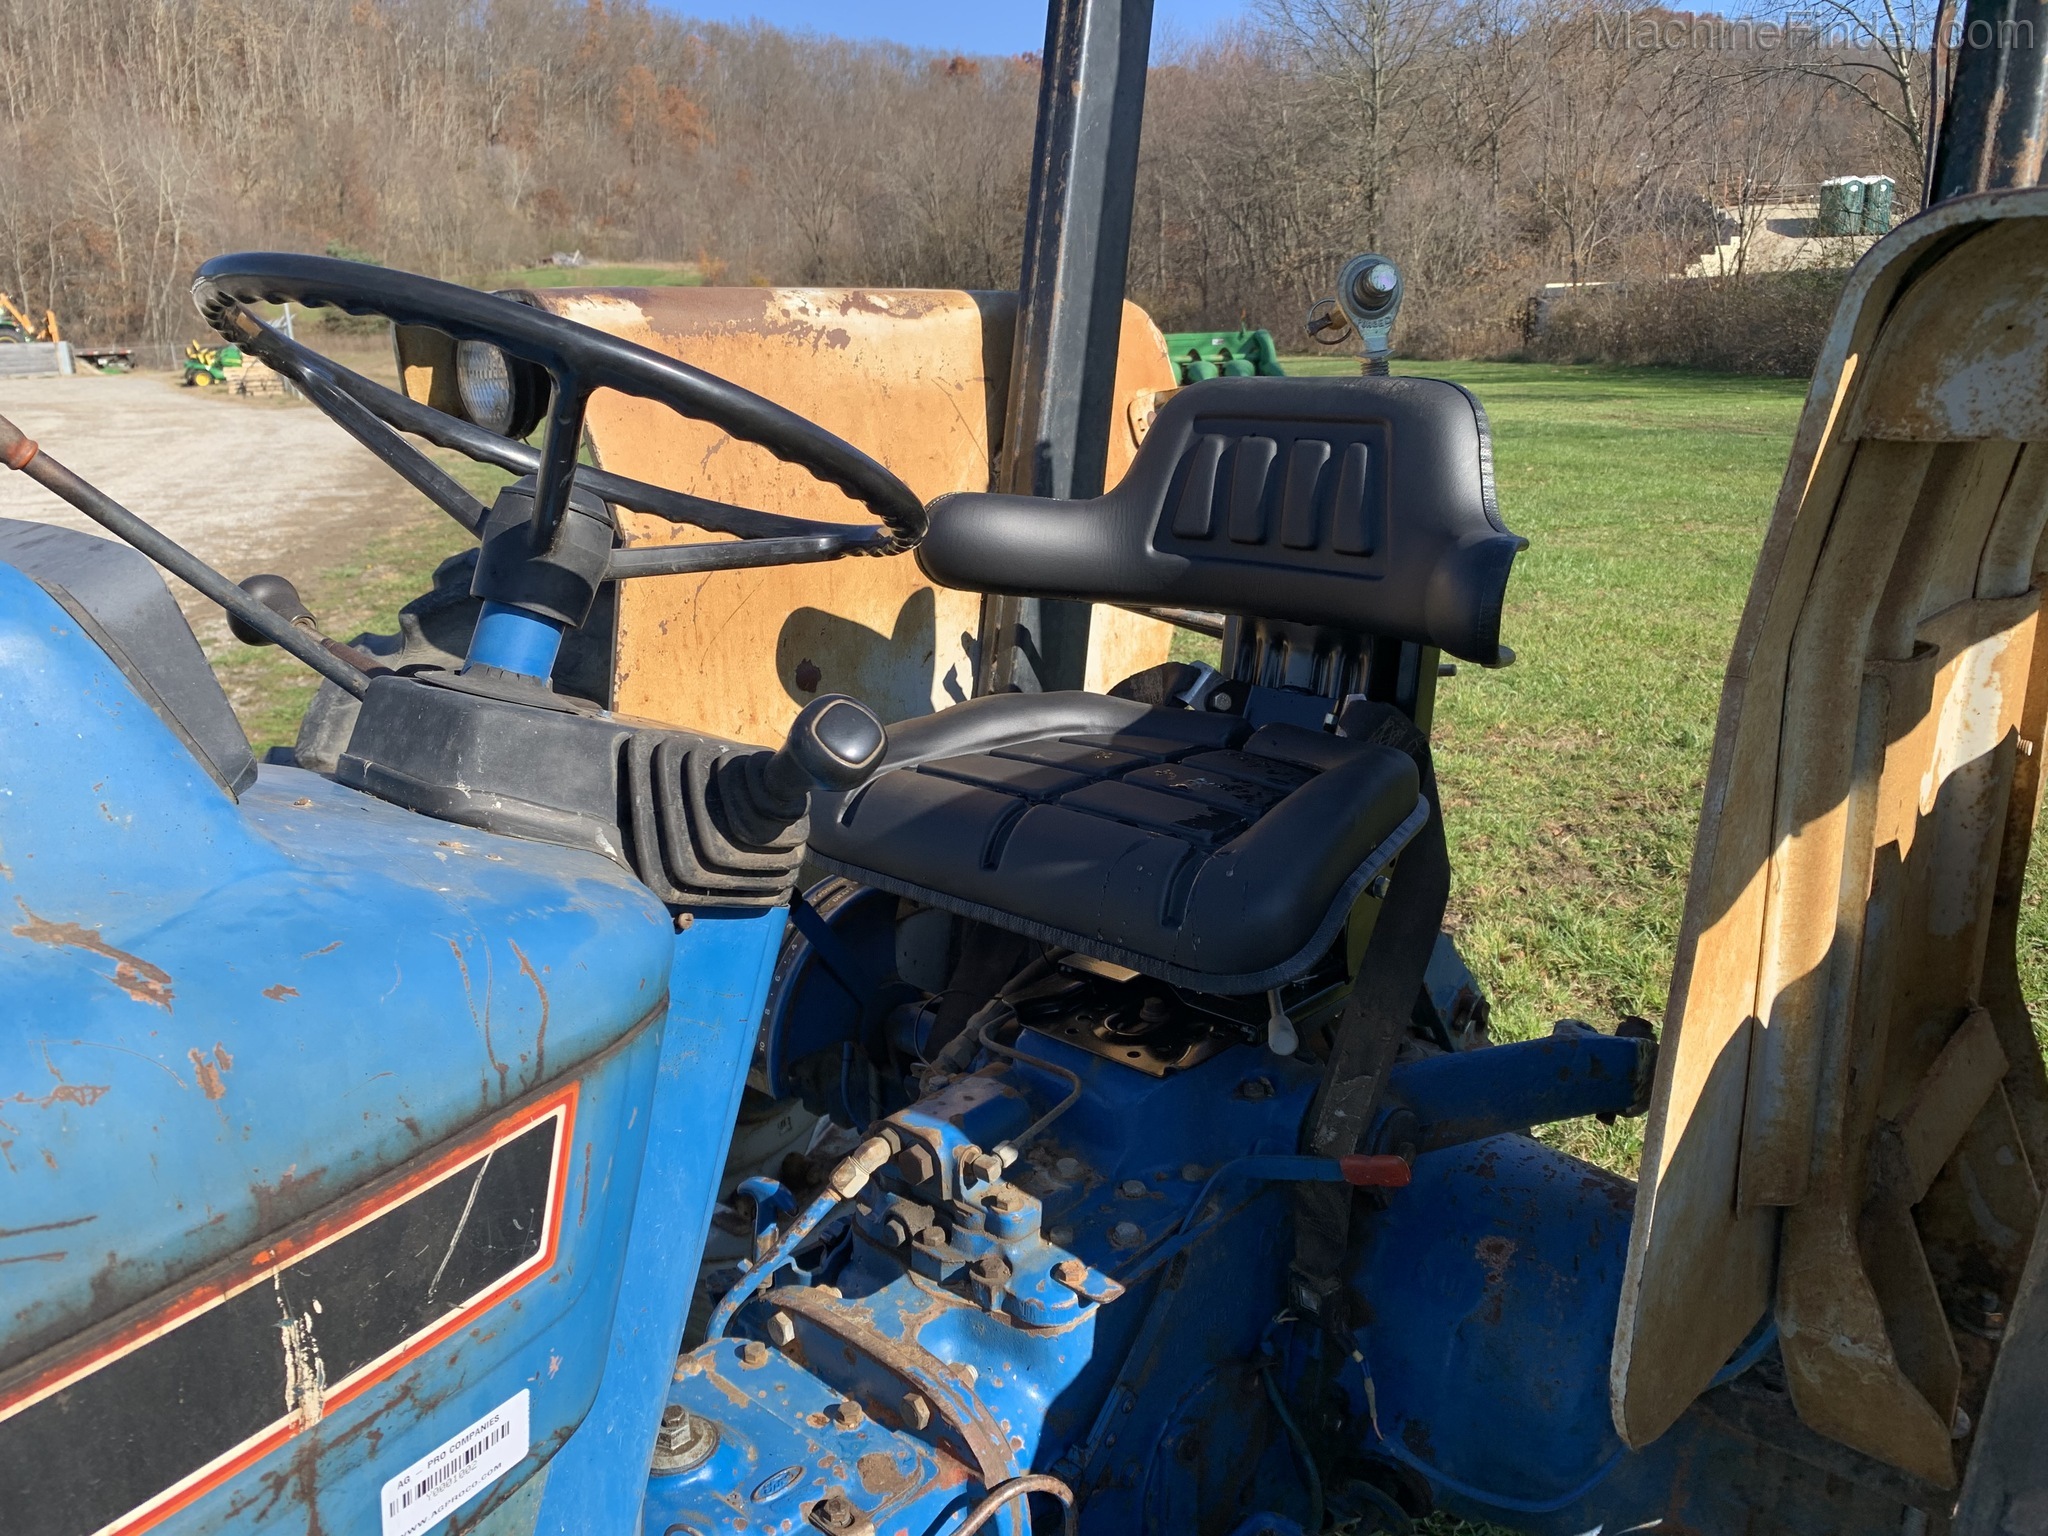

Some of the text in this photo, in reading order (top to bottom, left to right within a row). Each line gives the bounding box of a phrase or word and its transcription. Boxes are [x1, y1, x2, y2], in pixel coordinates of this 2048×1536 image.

[397, 1475, 411, 1490] AG
[427, 1451, 446, 1469] PRO
[449, 1414, 500, 1454] COMPANIES
